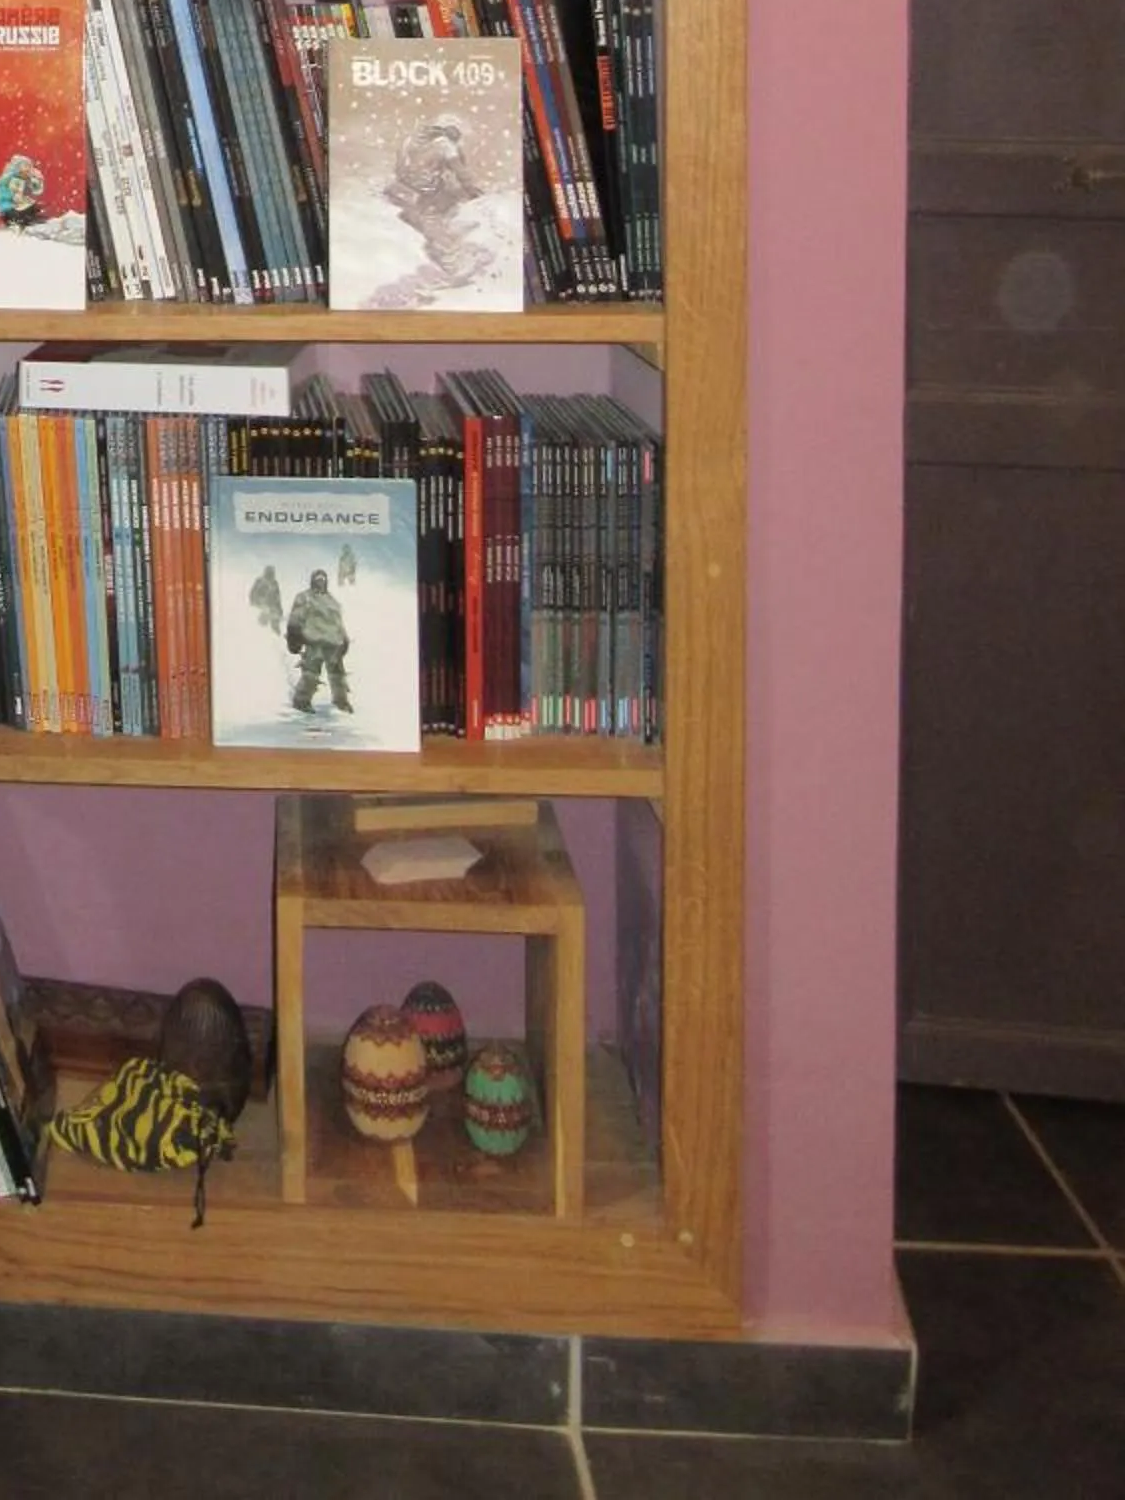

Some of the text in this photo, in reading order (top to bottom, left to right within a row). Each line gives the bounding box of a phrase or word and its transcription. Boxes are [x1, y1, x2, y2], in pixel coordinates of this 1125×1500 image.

[351, 60, 495, 87] BLOCK 109
[244, 510, 381, 525] ENDURANCE
